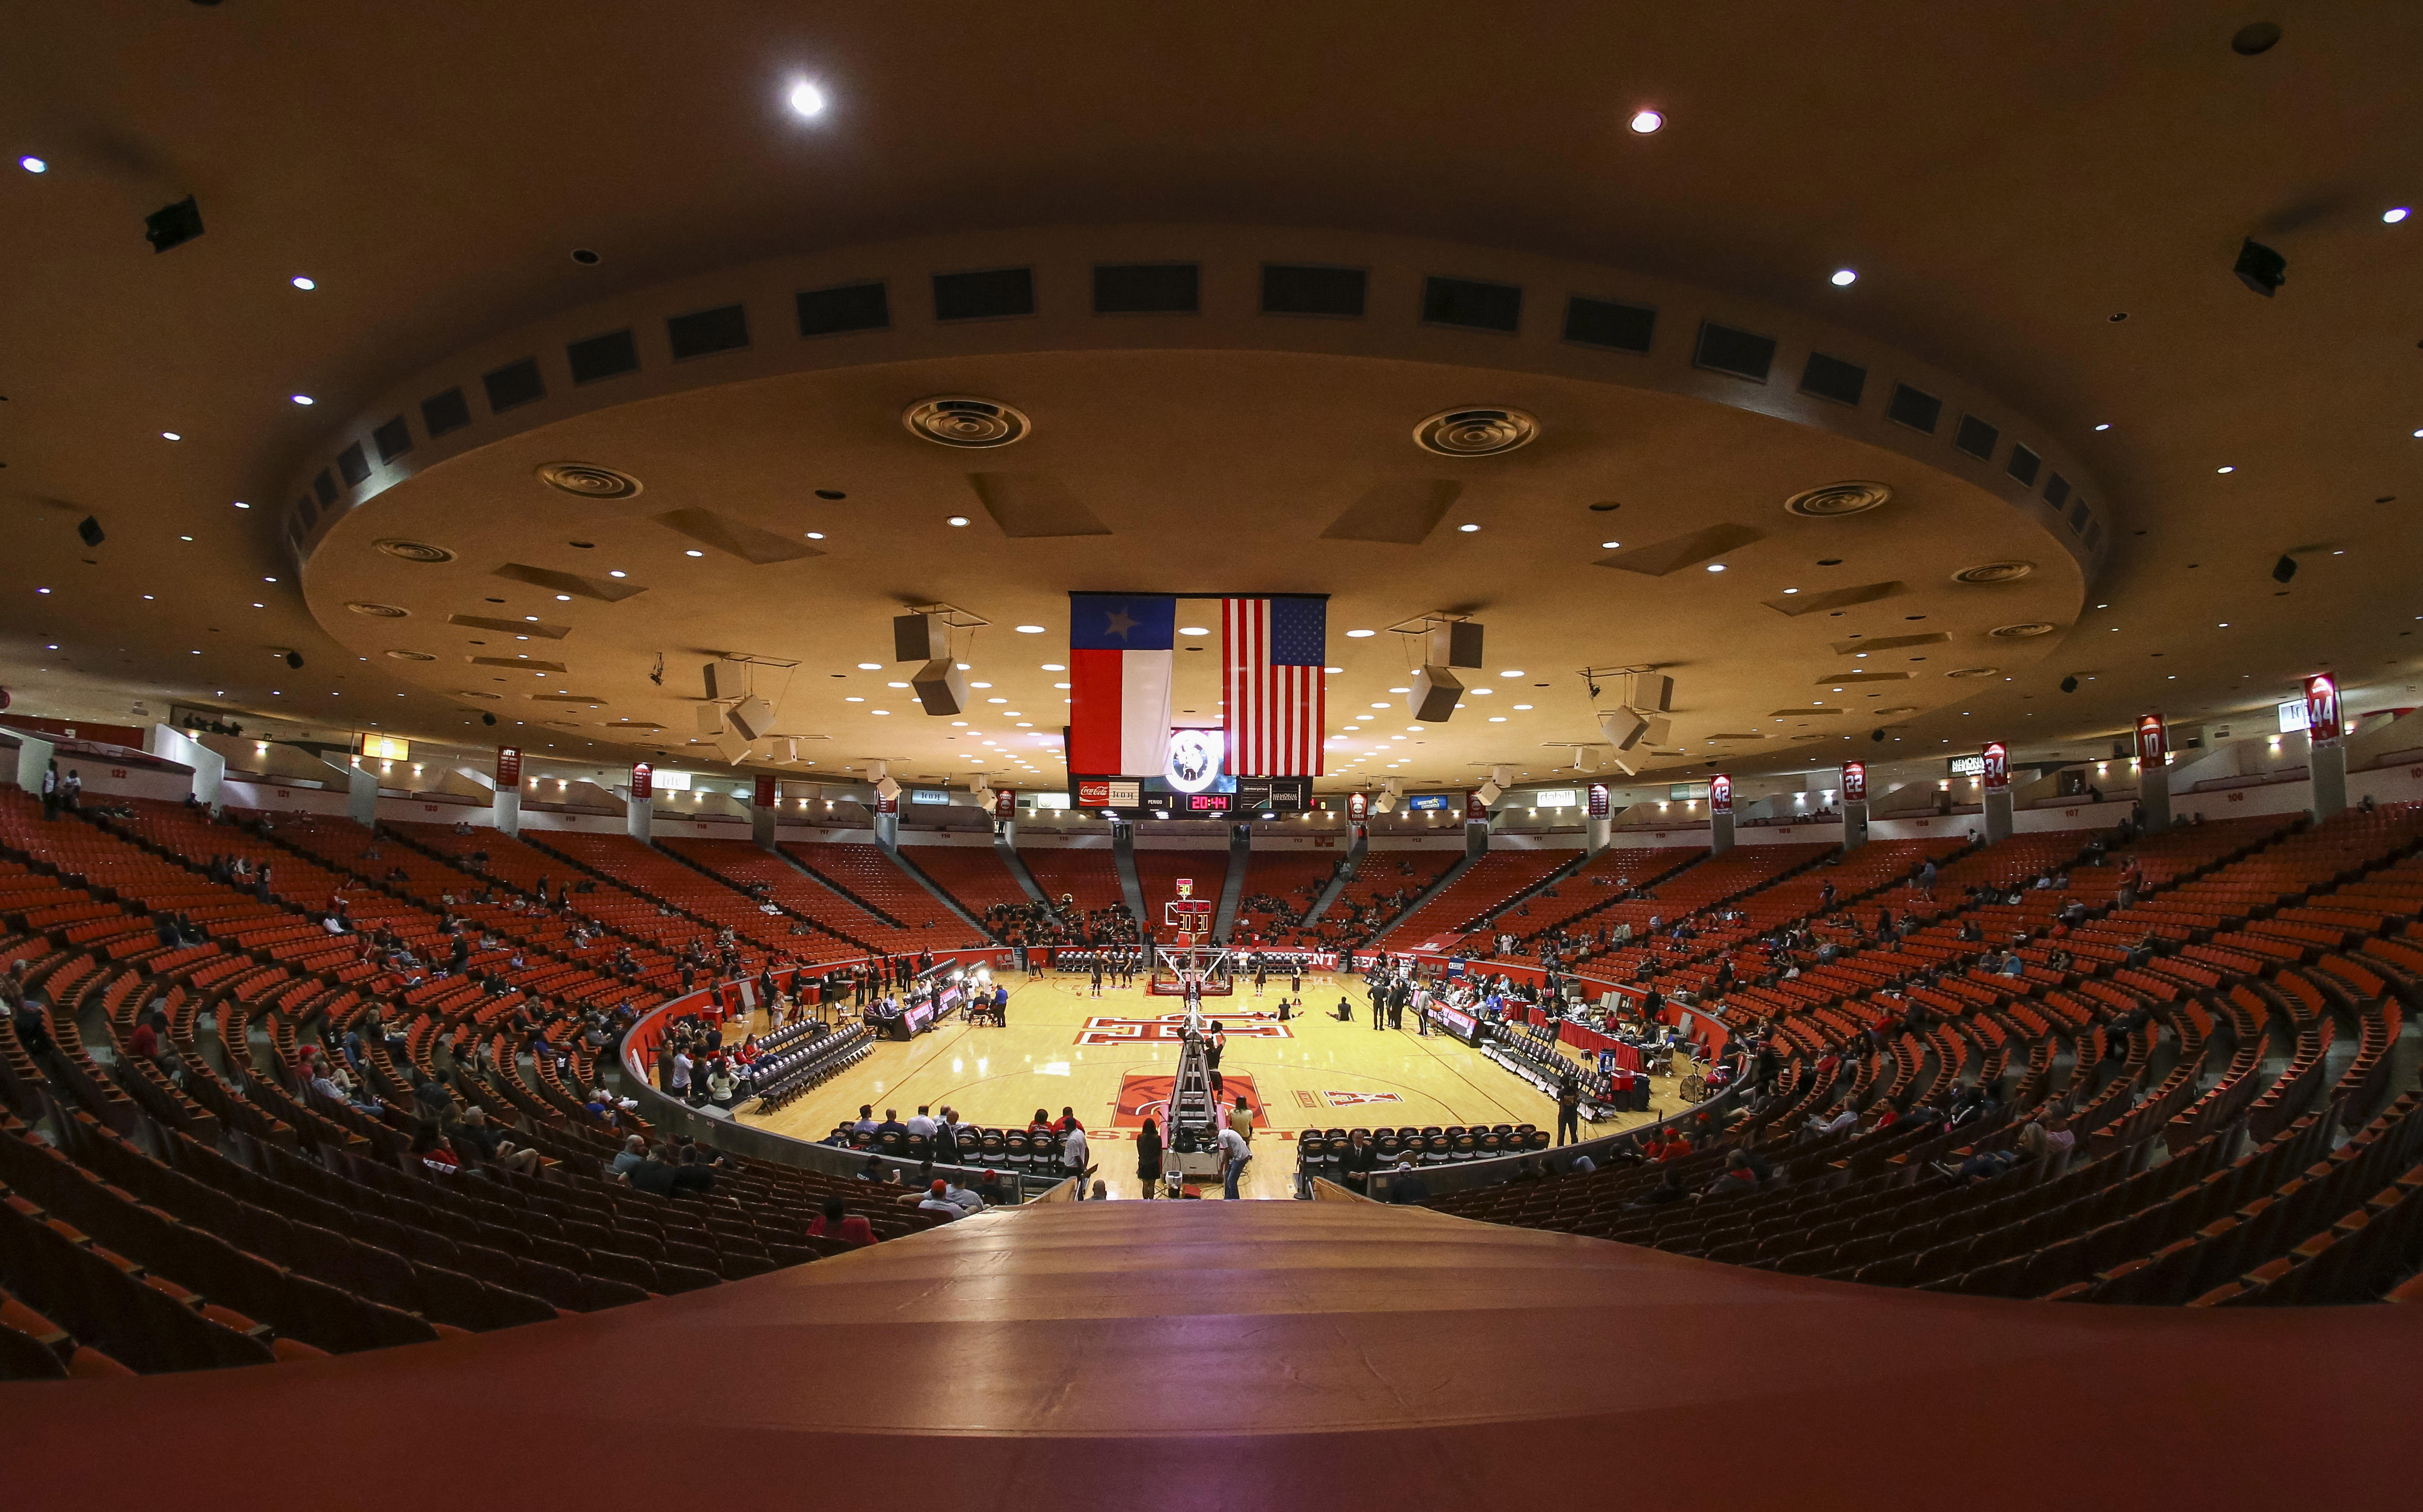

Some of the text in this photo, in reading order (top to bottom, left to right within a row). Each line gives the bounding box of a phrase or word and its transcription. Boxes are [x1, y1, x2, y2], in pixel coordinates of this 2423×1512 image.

[2311, 696, 2333, 727] 44
[2143, 733, 2159, 758] 10
[1952, 757, 1984, 766] MEMORIA
[1985, 757, 2004, 779] 34
[111, 769, 127, 779] 122
[1845, 774, 1863, 793] 22
[278, 789, 290, 798] 121
[1714, 786, 1730, 803] 42
[2228, 792, 2243, 802] 106
[1191, 796, 1228, 809] 20:44
[2065, 809, 2079, 817] 107
[1179, 885, 1190, 894] 30
[1179, 914, 1191, 931] 30
[1197, 914, 1208, 931] 30
